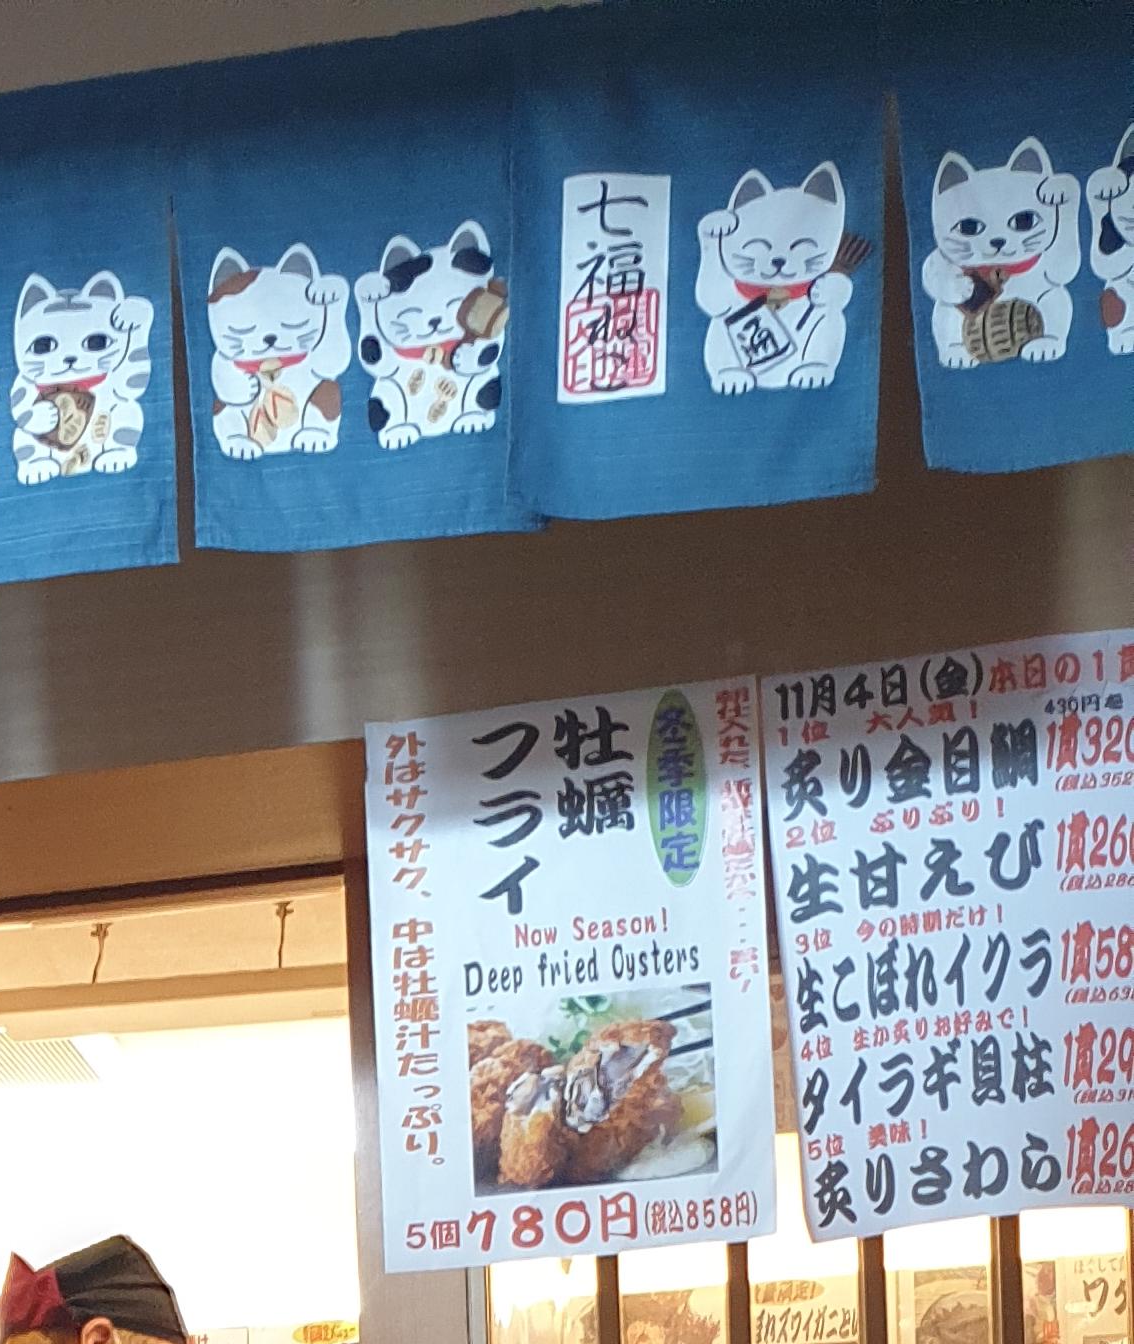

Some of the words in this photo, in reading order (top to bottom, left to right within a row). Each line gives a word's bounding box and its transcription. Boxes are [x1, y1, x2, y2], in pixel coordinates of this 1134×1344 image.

[777, 719, 831, 747] 1位
[472, 721, 542, 915] フライ
[785, 818, 838, 849] 2位
[786, 818, 1046, 925] 生甘えび
[515, 923, 558, 949] Now
[572, 906, 669, 942] Season!
[795, 927, 834, 956] 3位
[463, 960, 524, 997] Deep
[538, 947, 600, 988] fried
[611, 939, 700, 982] Oysters
[795, 927, 1053, 1035] 生こぼれイクラ
[799, 1036, 834, 1063] 4位
[802, 1031, 1056, 1136] タイラギ貝柱
[806, 1133, 846, 1162] 5位
[813, 1130, 1063, 1229] 炙りさわら
